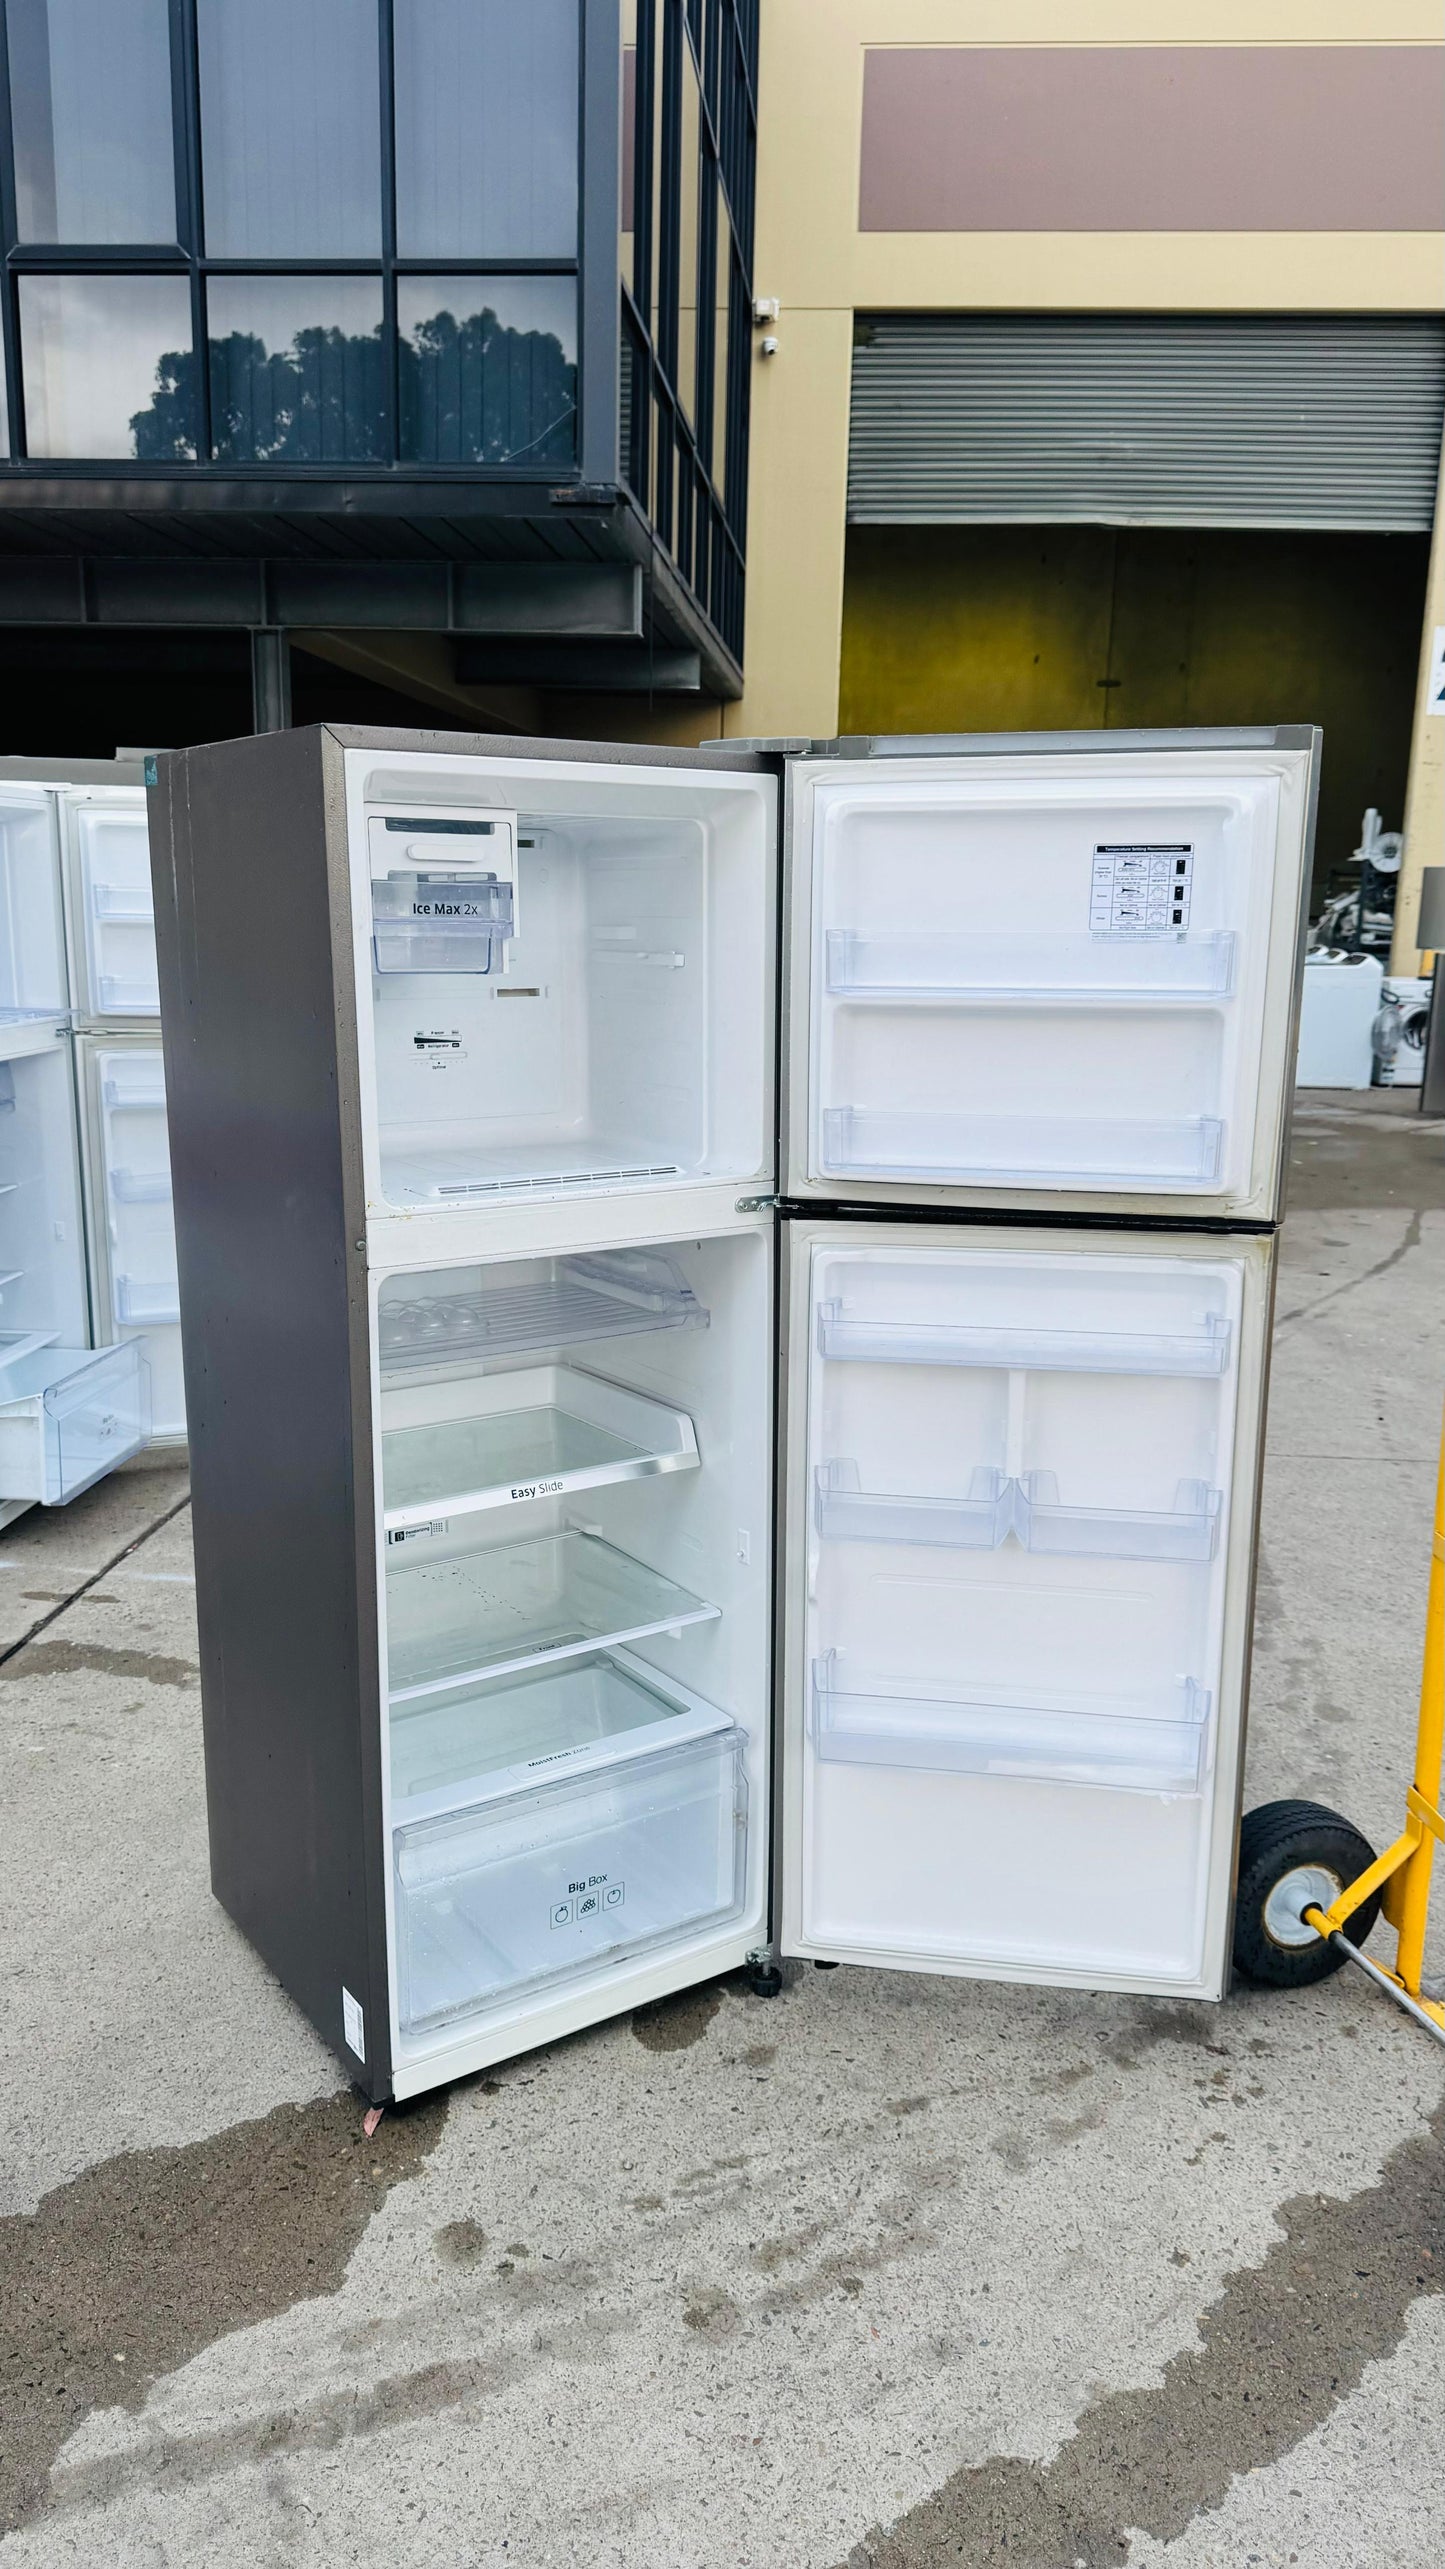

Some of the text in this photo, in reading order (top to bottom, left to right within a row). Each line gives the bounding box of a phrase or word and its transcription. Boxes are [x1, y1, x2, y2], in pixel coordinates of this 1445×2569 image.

[413, 903, 478, 915] Ice Max 2x
[511, 1481, 564, 1499] Easy Slide
[527, 1752, 572, 1767] MoistFresh
[568, 1874, 608, 1893] Big Box
